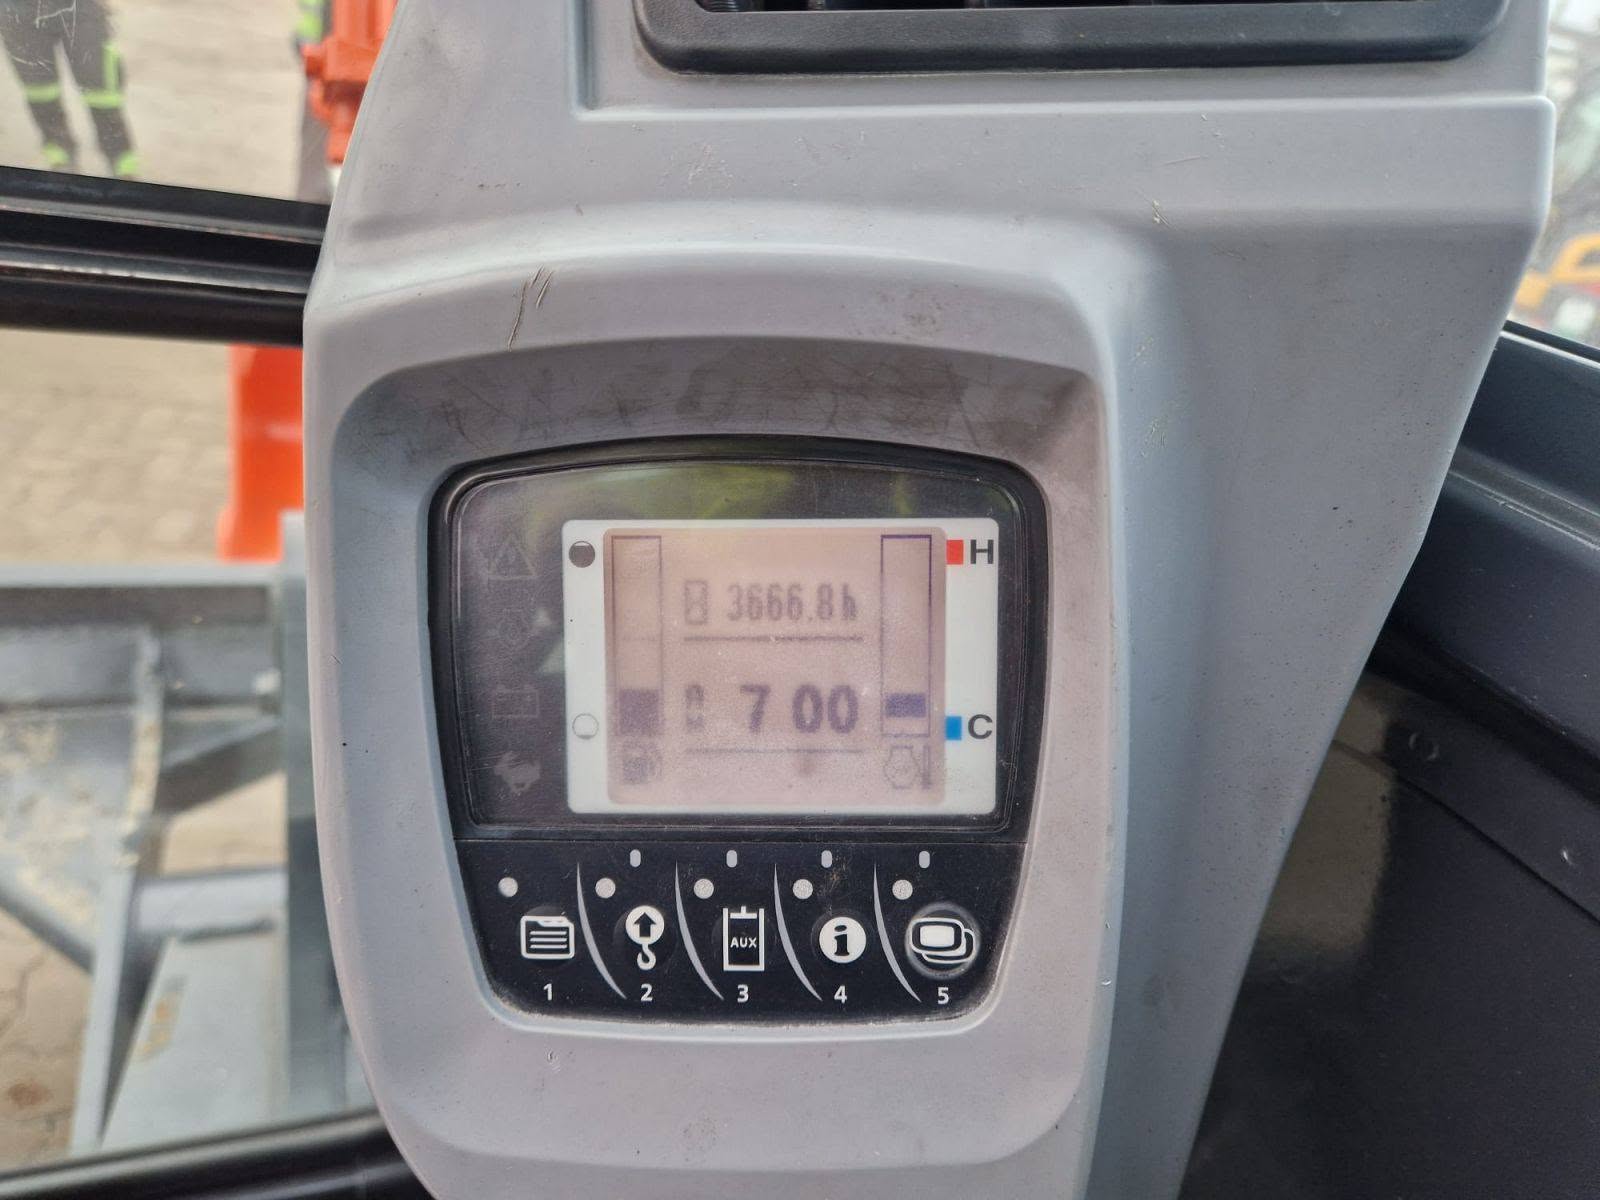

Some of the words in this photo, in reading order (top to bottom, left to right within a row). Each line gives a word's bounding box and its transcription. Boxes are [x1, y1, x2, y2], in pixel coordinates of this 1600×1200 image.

[970, 539, 995, 565] H
[967, 713, 993, 740] C
[730, 936, 757, 949] AUX
[543, 983, 553, 1001] 1
[640, 983, 653, 1002] 2
[737, 984, 749, 1003] 3
[833, 985, 848, 1004] 4
[937, 986, 950, 1005] 5
